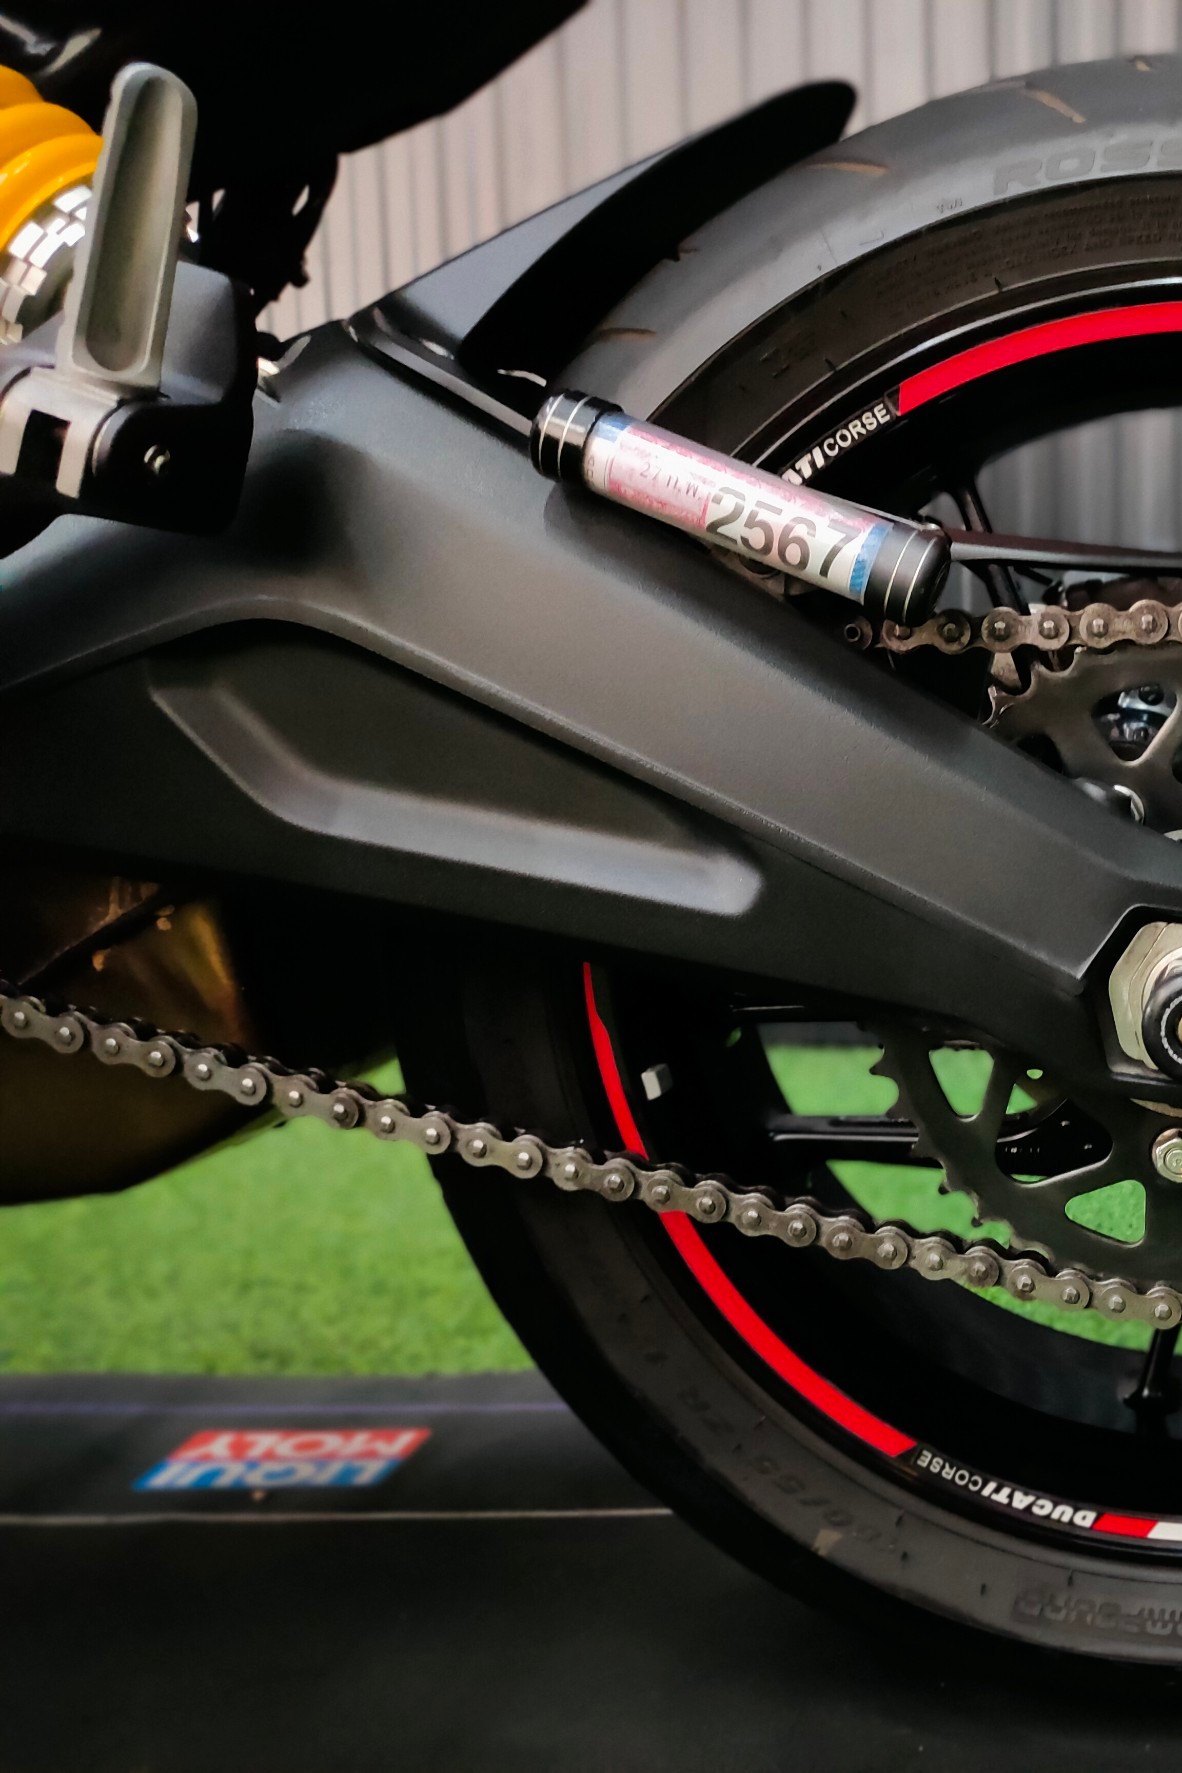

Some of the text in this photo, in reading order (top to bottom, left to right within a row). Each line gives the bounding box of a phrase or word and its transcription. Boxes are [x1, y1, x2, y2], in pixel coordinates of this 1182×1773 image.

[782, 403, 890, 485] ATI CORSE
[705, 486, 863, 579] 2567
[142, 1460, 391, 1488] LIQUI
[170, 1431, 420, 1460] MOLY
[919, 1449, 1097, 1529] DUCATI CORSE
